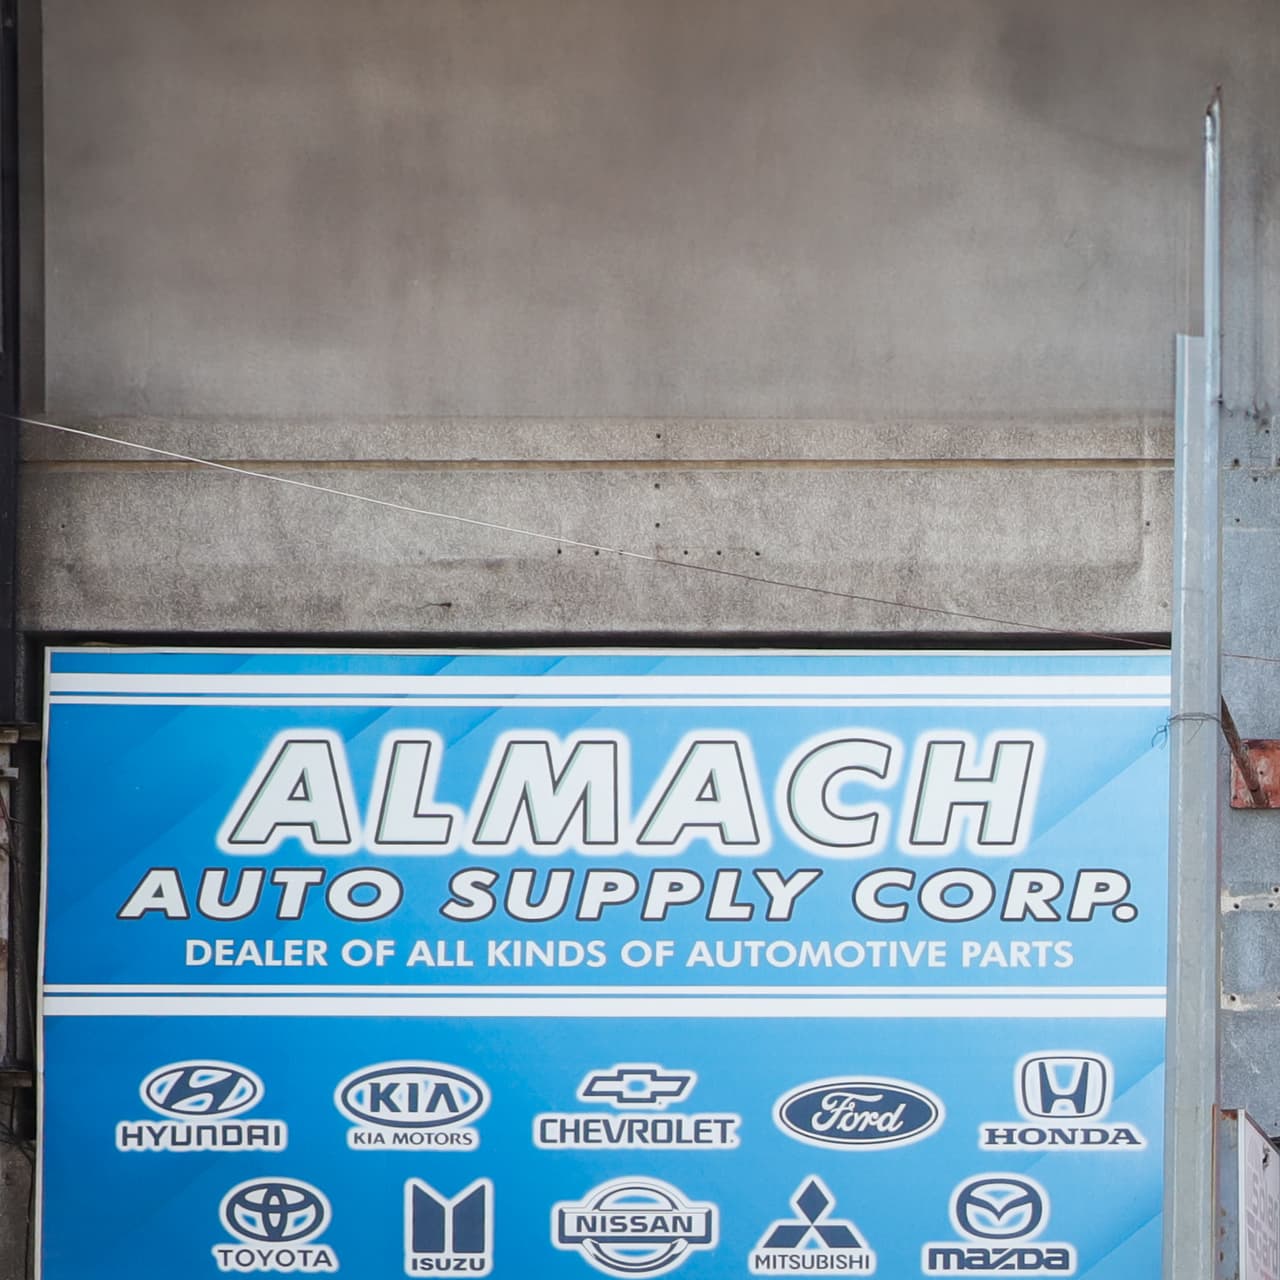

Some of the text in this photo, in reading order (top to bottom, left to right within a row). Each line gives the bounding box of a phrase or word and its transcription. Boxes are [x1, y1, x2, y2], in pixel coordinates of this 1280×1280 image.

[226, 737, 1040, 850] ALMACH
[118, 867, 1140, 923] AUTO SUPPLY CORP.
[185, 938, 1073, 968] DEALER OF ALL KINDS OF AUTOMOTIVE PARTS
[368, 1081, 460, 1114] KIA
[810, 1090, 905, 1134] Ford
[121, 1125, 281, 1148] HYUNDAI
[353, 1131, 473, 1146] KIA MOTORS
[538, 1117, 735, 1144] CHEVROLET
[983, 1127, 1142, 1146] HONDA
[575, 1214, 693, 1234] NISSAN
[218, 1249, 333, 1268] TOYOTA
[412, 1257, 486, 1272] ISUZU
[754, 1254, 870, 1271] MITSUBISHI
